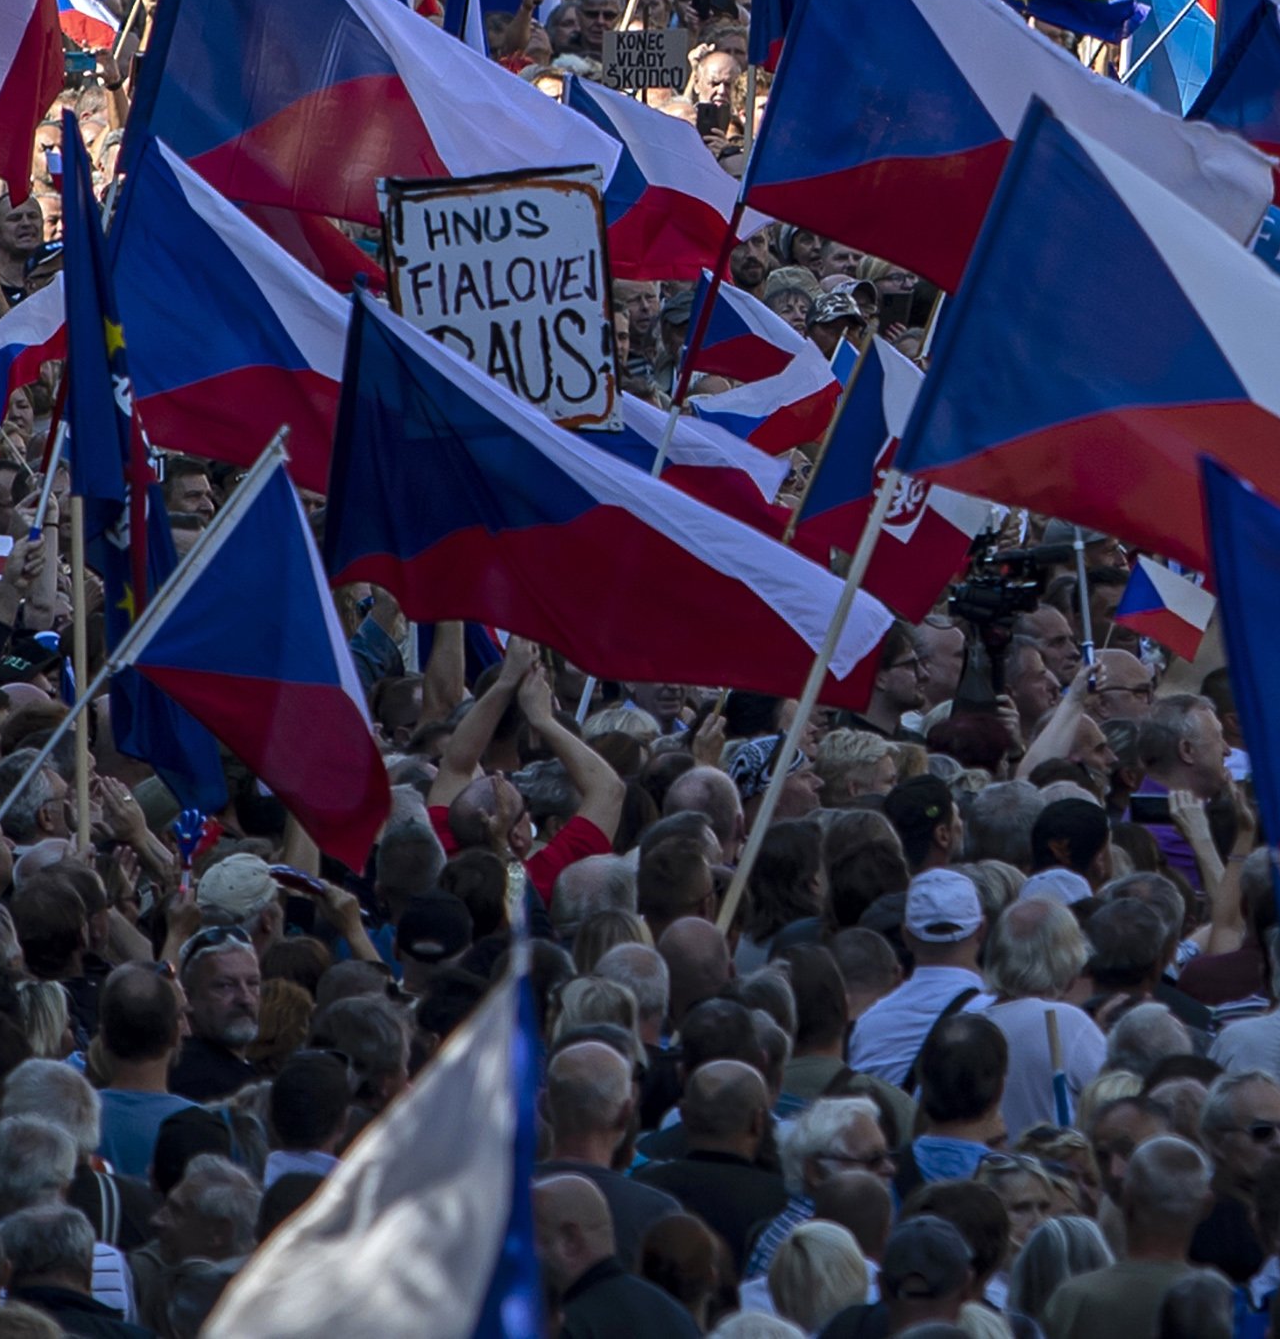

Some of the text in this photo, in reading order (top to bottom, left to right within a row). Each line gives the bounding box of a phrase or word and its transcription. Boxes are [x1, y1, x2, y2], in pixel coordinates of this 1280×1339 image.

[616, 33, 665, 51] KONEC
[423, 200, 550, 251] HNUS
[407, 248, 598, 316] FIALOVEJ
